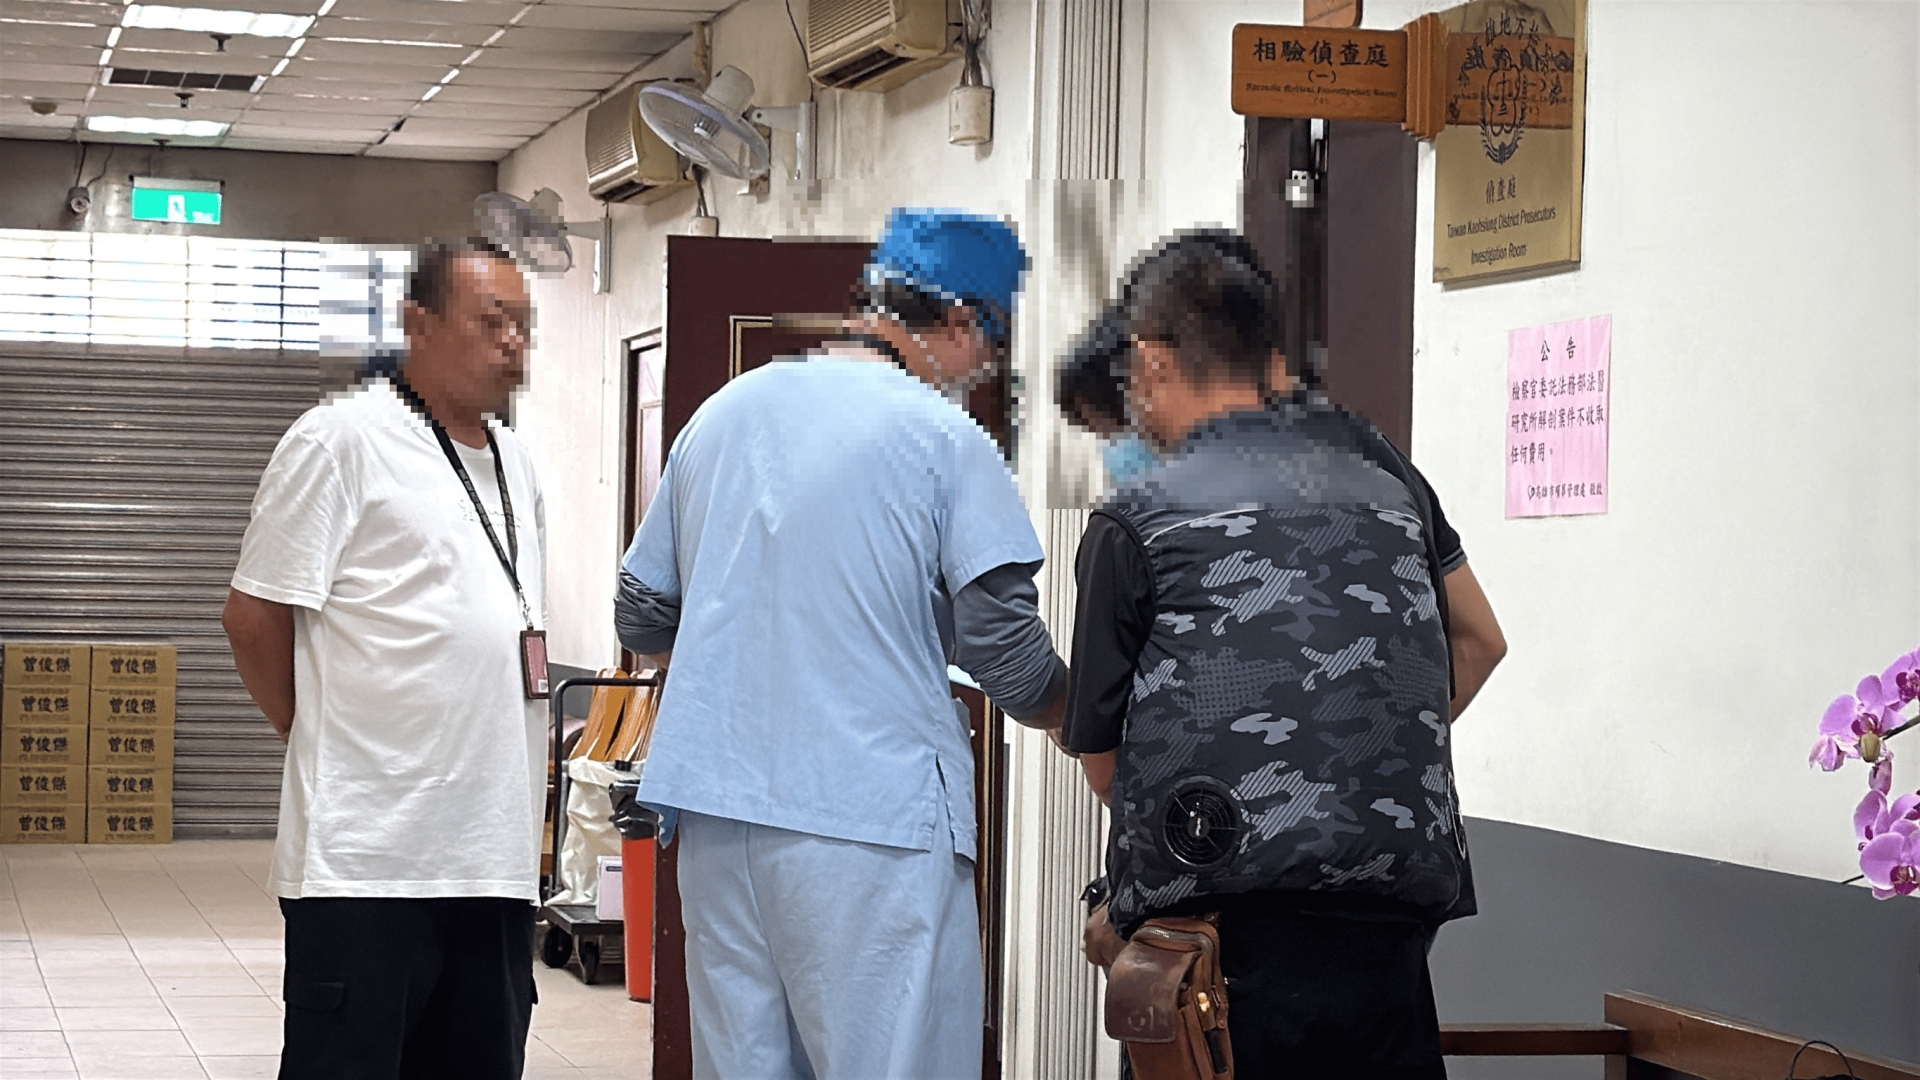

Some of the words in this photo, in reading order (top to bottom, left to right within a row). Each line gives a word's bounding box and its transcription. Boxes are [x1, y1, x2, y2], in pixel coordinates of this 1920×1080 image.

[1253, 37, 1389, 68] 相驗偵查庭
[1307, 69, 1337, 83] (一)
[1486, 175, 1516, 203] 偵查庭
[1447, 223, 1466, 238] Taiwan
[1467, 217, 1498, 234] Kaohsiung
[1498, 212, 1520, 230] District
[1521, 206, 1556, 225] Prosecutors
[1471, 246, 1507, 265] Investigation
[1508, 242, 1527, 258] Room
[1511, 404, 1604, 433] 研究所解剖案件不收取
